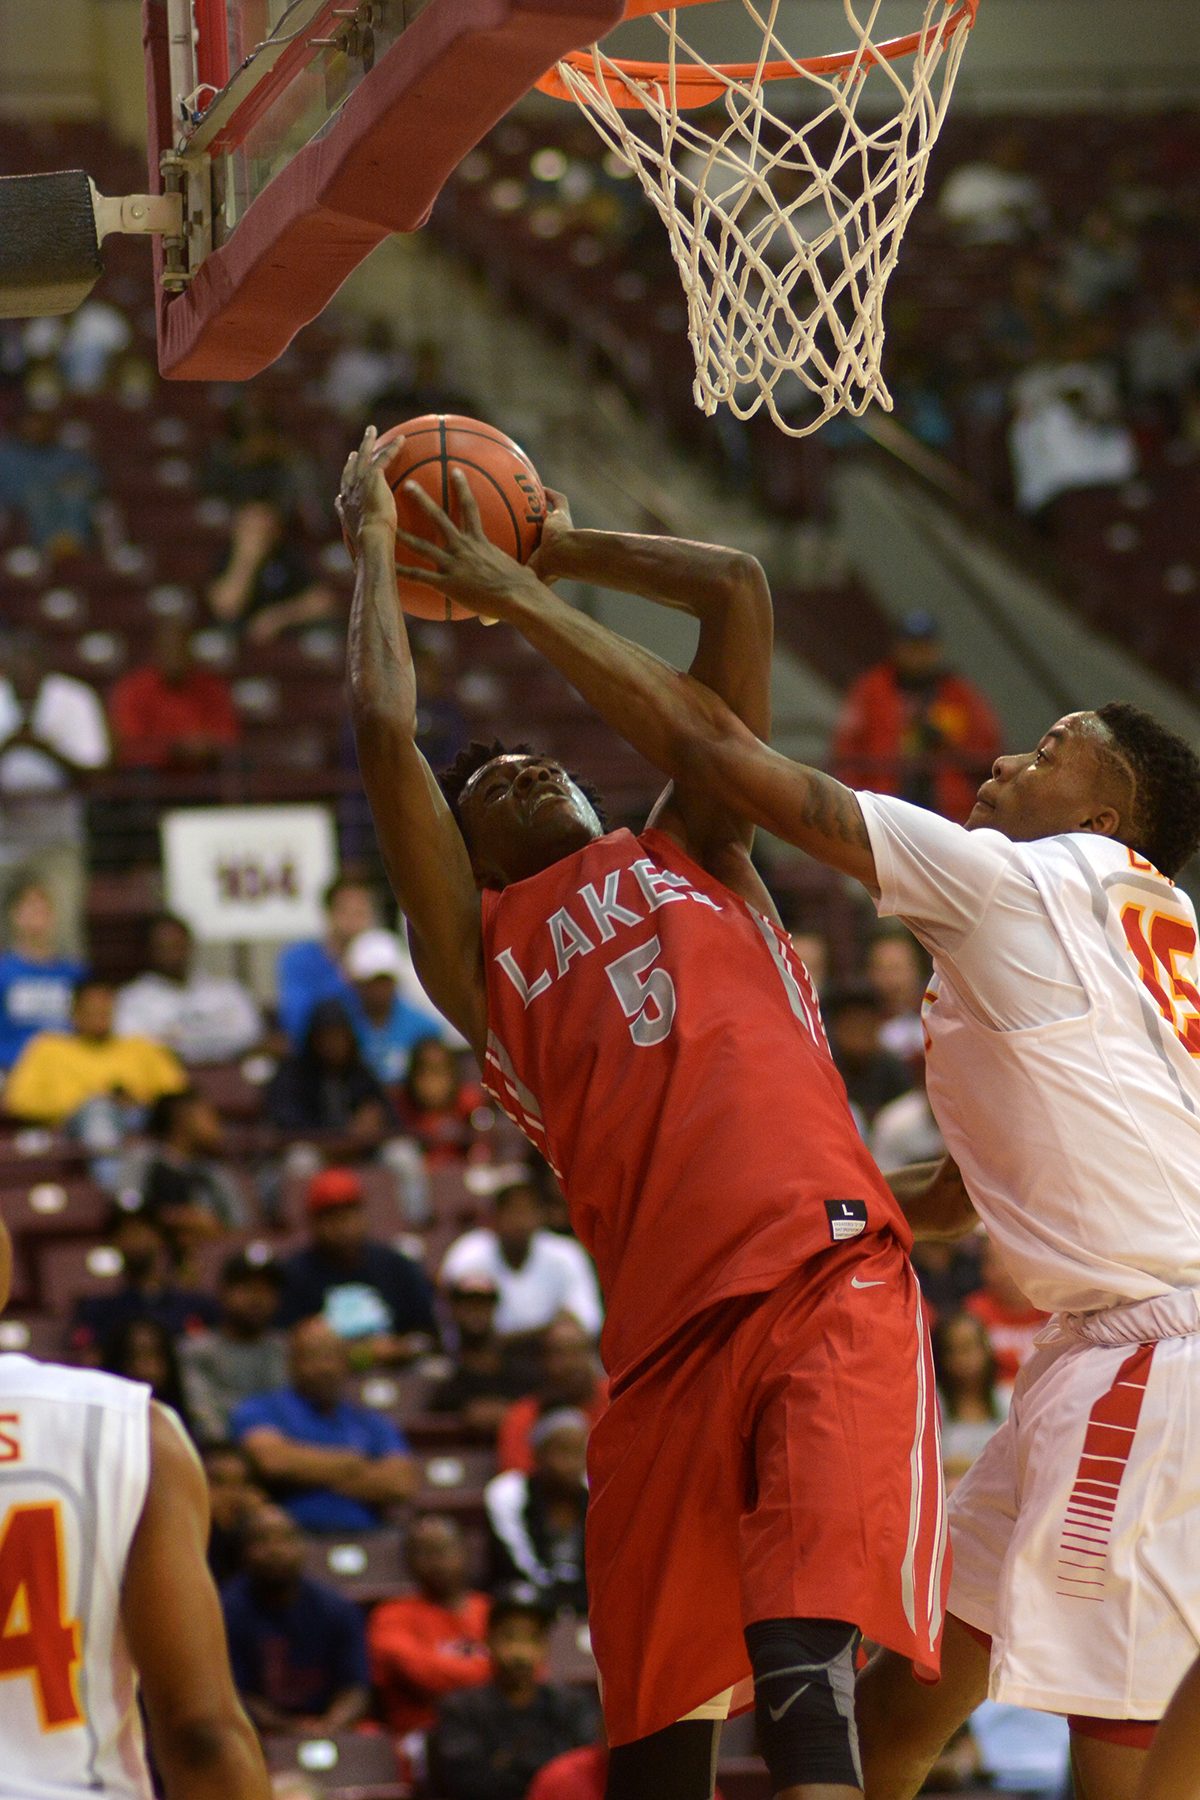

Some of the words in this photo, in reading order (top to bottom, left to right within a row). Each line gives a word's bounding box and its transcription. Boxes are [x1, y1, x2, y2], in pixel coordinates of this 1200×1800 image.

[494, 858, 722, 1011] LAKE
[604, 934, 676, 1047] 5
[841, 1203, 854, 1216] L
[0, 1500, 87, 1736] 4
